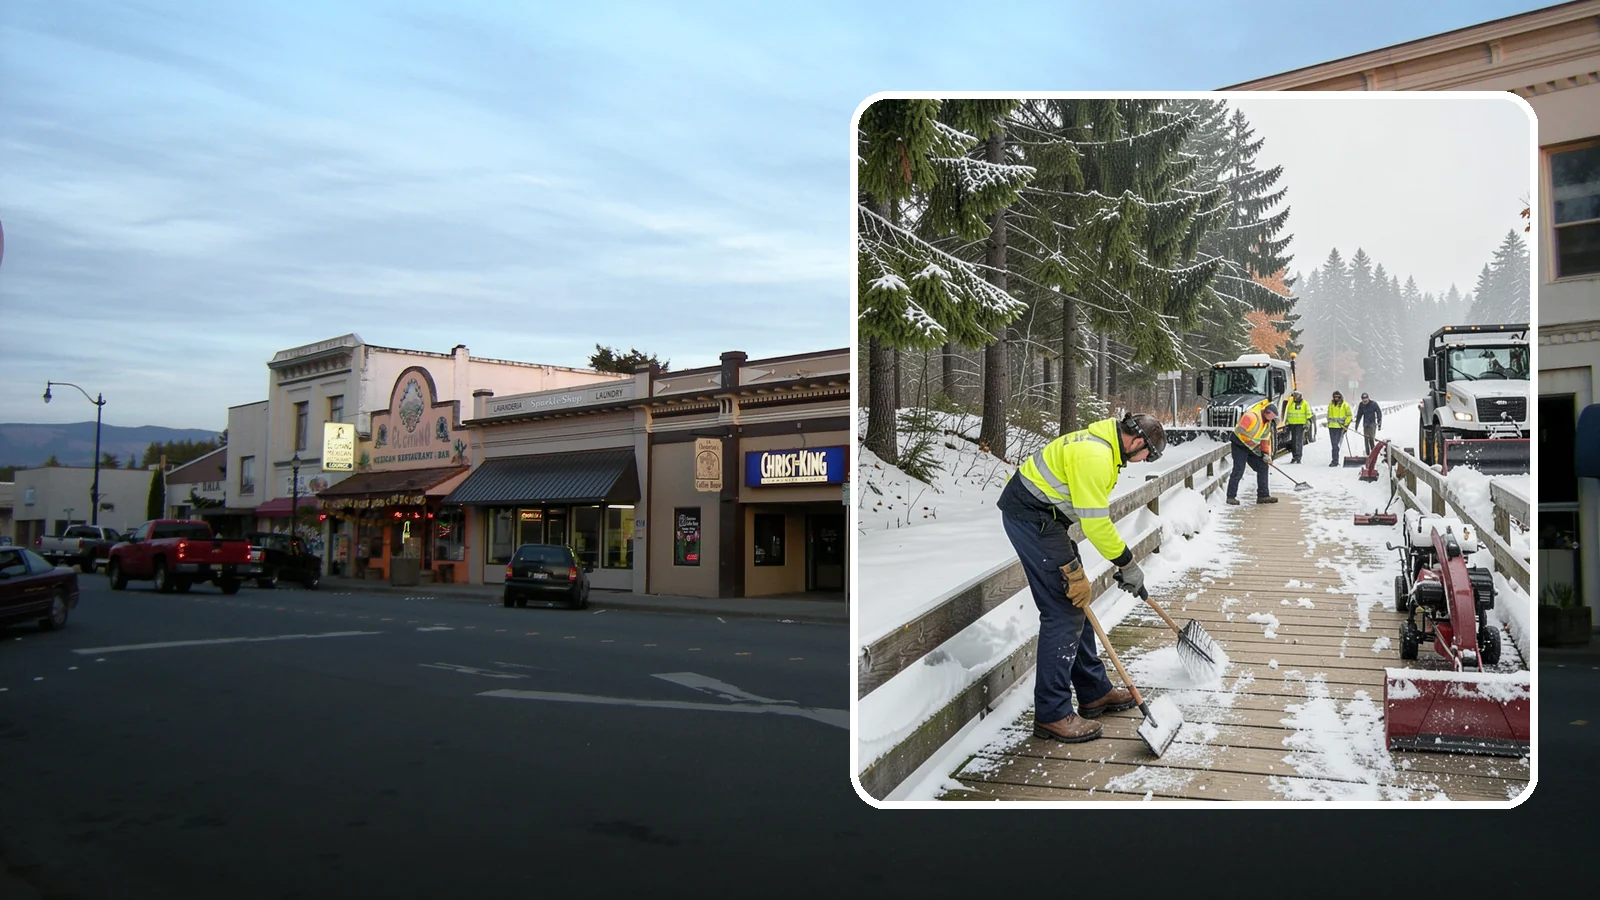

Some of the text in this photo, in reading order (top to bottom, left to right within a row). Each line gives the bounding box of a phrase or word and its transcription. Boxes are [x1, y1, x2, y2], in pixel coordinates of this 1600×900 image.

[596, 389, 624, 400] LAUNDRY
[494, 402, 523, 413] LAVANDERIA
[531, 395, 583, 409] Sparkle Shop
[397, 451, 434, 463] RESTAURANT
[438, 450, 450, 460] BAR
[761, 452, 797, 479] CHRIST
[799, 450, 828, 477] KING
